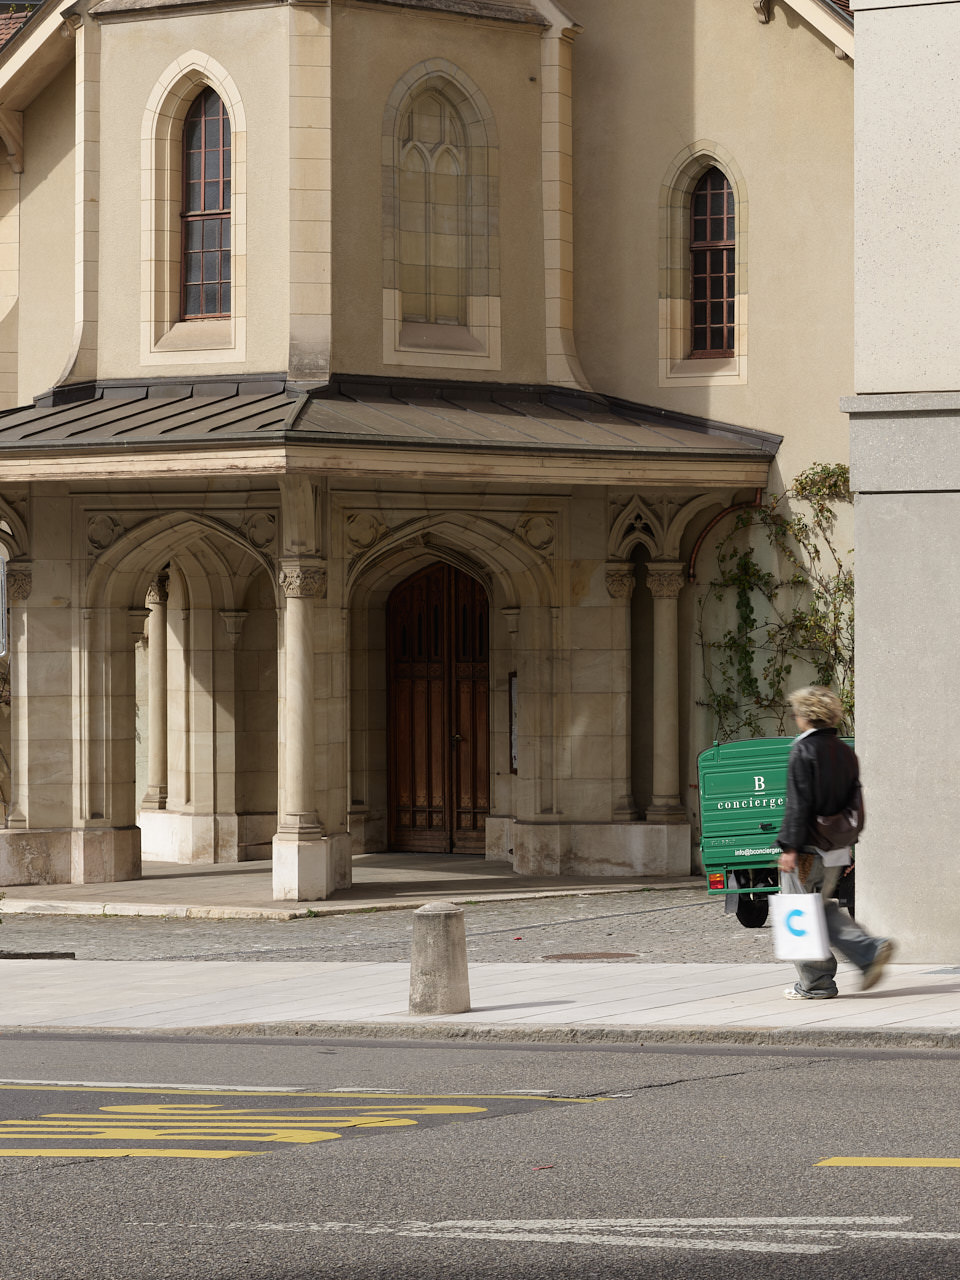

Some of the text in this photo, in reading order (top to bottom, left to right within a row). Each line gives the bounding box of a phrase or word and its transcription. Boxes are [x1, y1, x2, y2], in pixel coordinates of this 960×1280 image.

[753, 775, 766, 791] B
[717, 797, 787, 810] concierge
[785, 909, 807, 937] C
